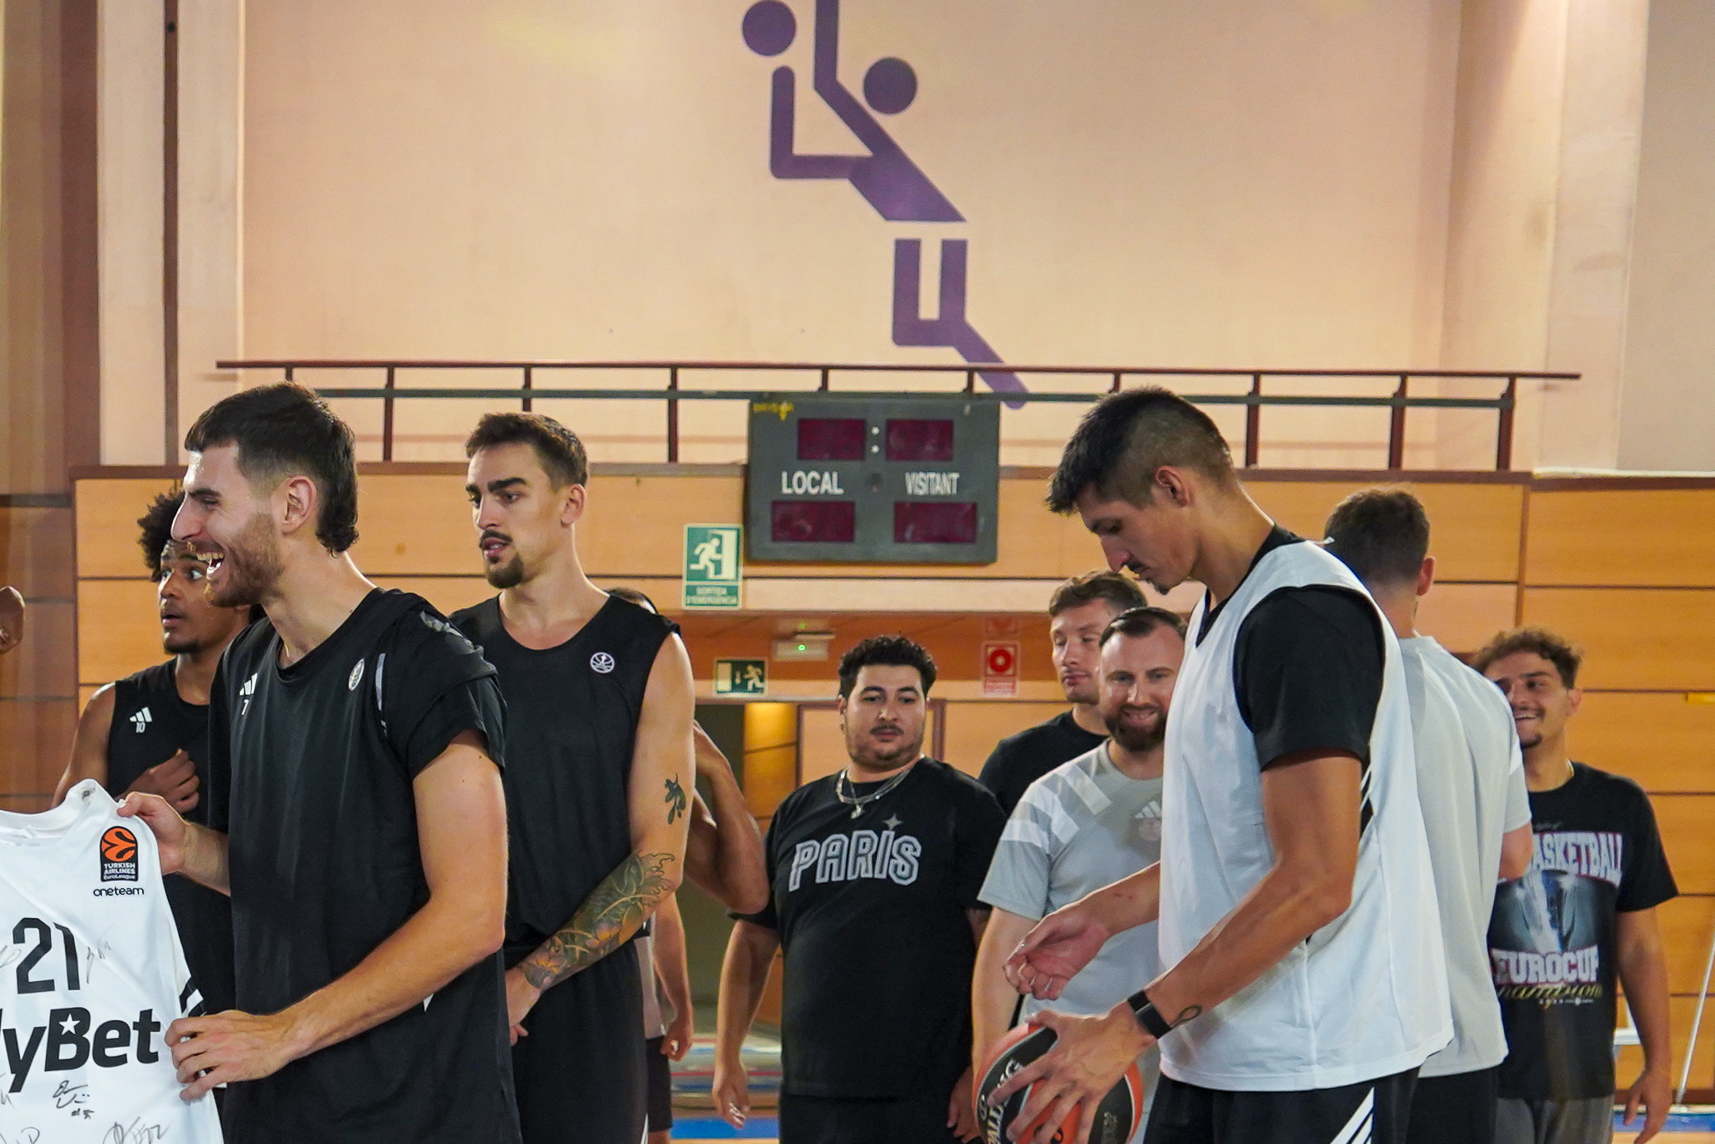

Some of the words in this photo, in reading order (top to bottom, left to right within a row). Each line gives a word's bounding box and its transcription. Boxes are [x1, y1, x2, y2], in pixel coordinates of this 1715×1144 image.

[782, 470, 845, 495] LOCAL
[905, 471, 960, 496] VISITANT
[241, 699, 249, 715] 7
[135, 722, 146, 733] 10
[788, 829, 922, 892] PARIS
[1532, 831, 1623, 888] ASKETBALL
[93, 886, 145, 897] oneteam
[12, 917, 80, 995] 21
